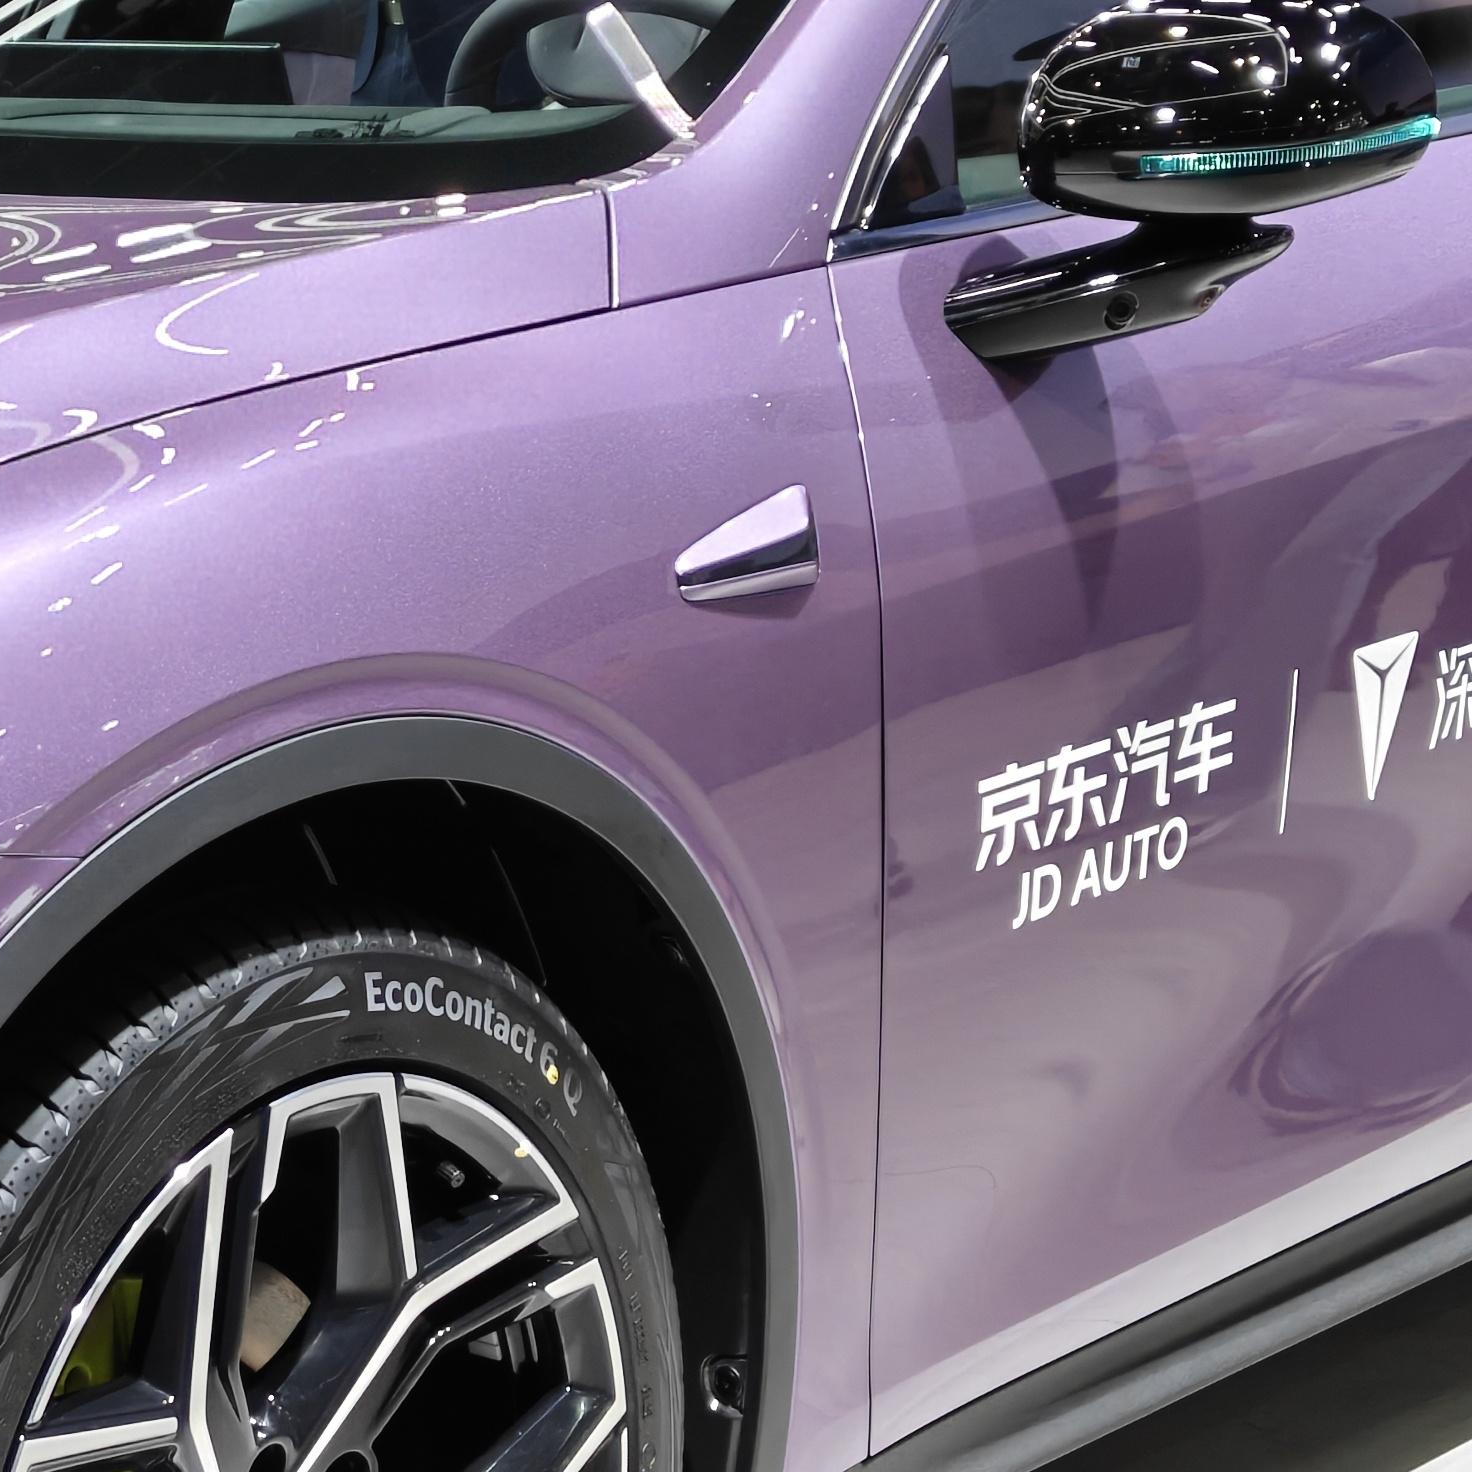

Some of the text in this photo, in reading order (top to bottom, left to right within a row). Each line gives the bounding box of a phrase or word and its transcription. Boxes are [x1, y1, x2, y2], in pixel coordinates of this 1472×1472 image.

[975, 699, 1237, 872] 京东汽车
[1012, 816, 1188, 930] JD AUTO
[364, 971, 536, 1064] EcoContact
[563, 1068, 583, 1117] Q
